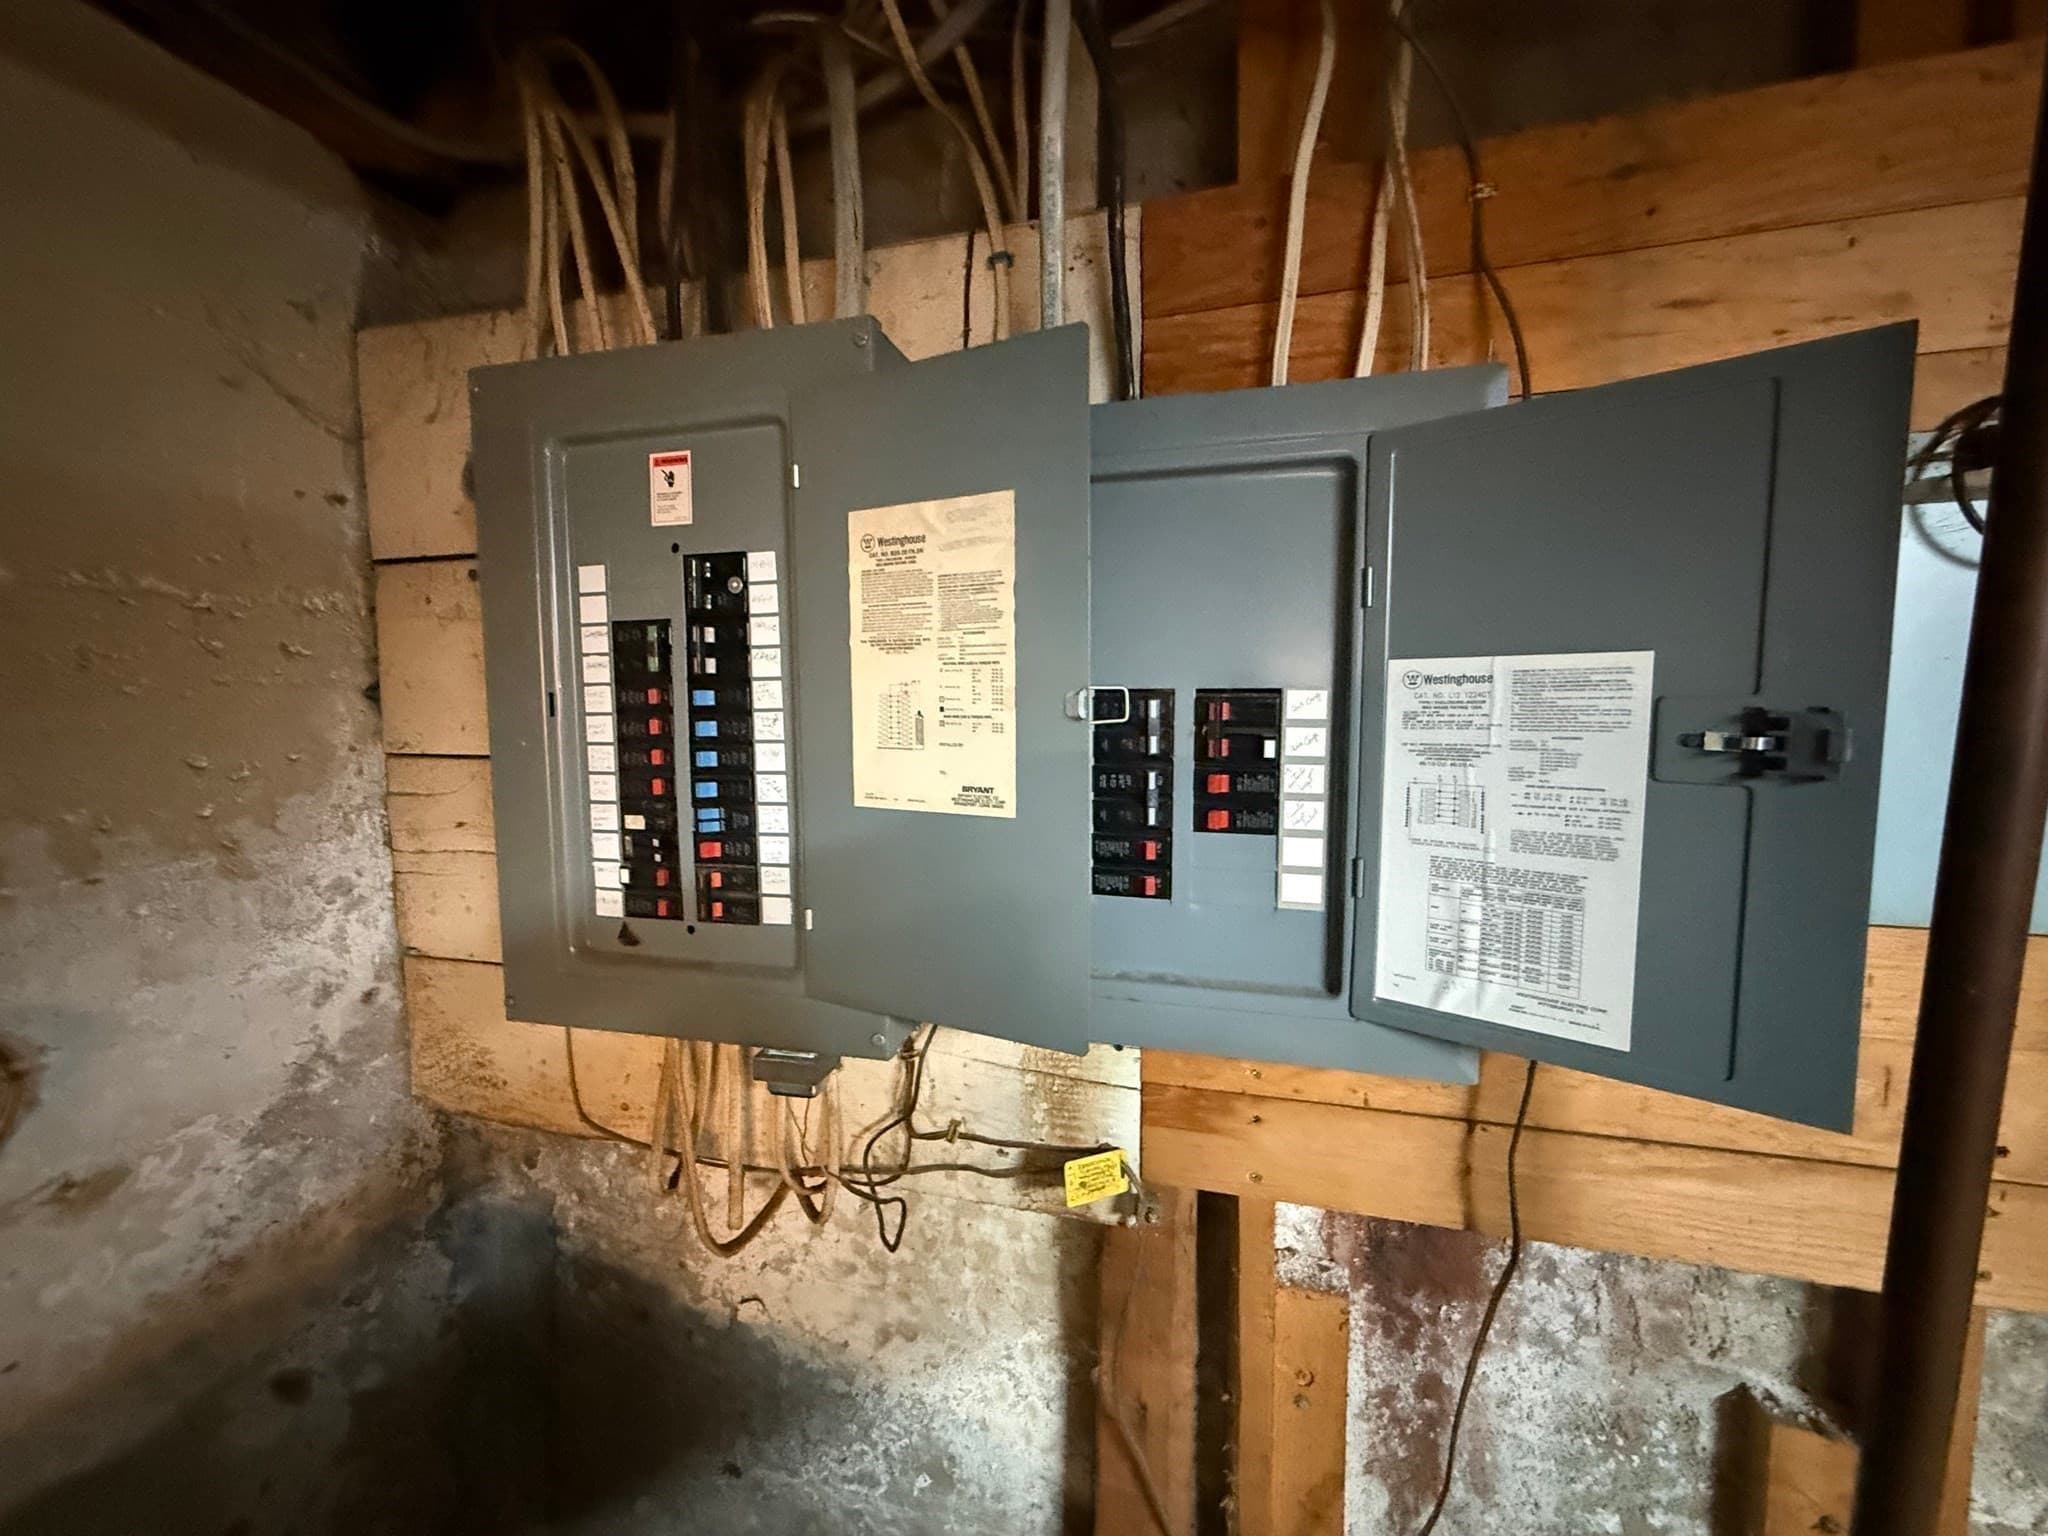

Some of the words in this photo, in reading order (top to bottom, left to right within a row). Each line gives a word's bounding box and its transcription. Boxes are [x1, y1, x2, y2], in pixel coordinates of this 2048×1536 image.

[877, 534, 926, 547] Westinghouse
[1423, 673, 1493, 686] Westinghouse
[962, 785, 994, 794] BRYANT
